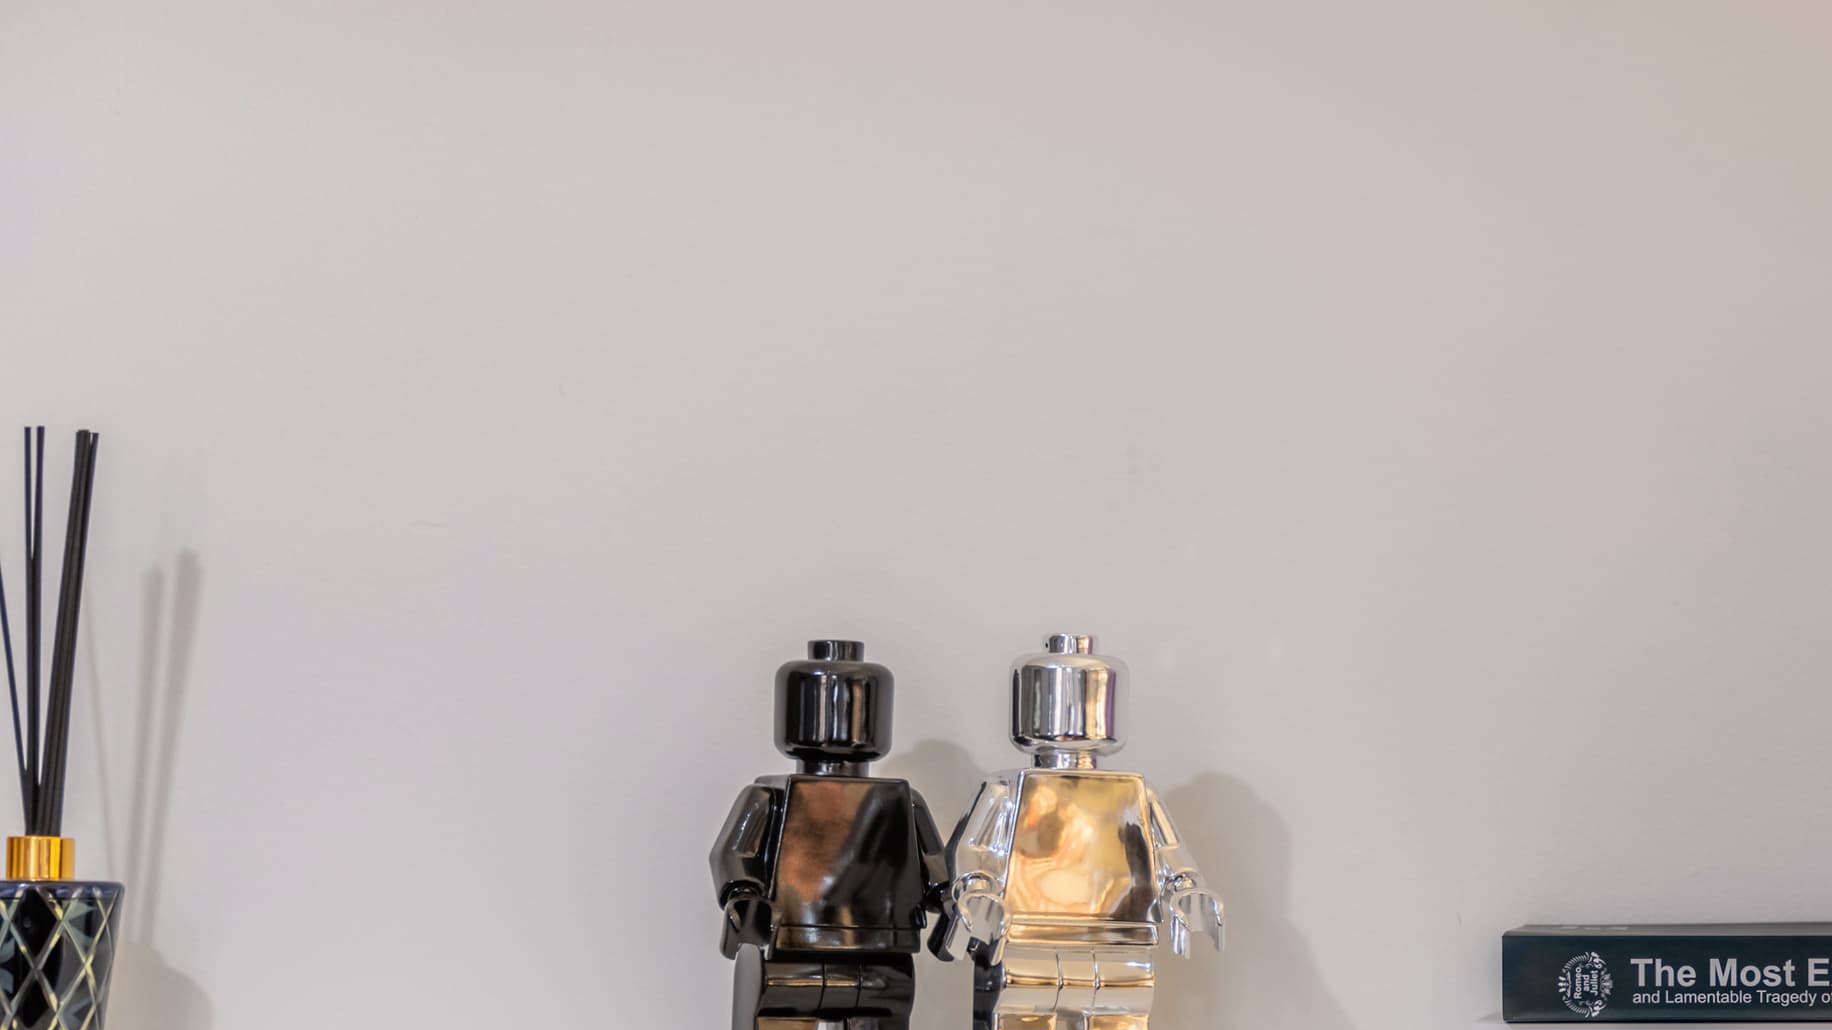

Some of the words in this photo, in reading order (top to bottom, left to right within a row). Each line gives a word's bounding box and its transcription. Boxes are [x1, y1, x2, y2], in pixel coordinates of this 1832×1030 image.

[1573, 966, 1582, 999] Romeo
[1590, 970, 1599, 996] Juliet
[1629, 957, 1697, 988] The
[1708, 957, 1796, 988] Most
[1632, 990, 1661, 1004] and
[1665, 989, 1752, 1004] Lamentable
[1756, 990, 1817, 1007] Tragedy
